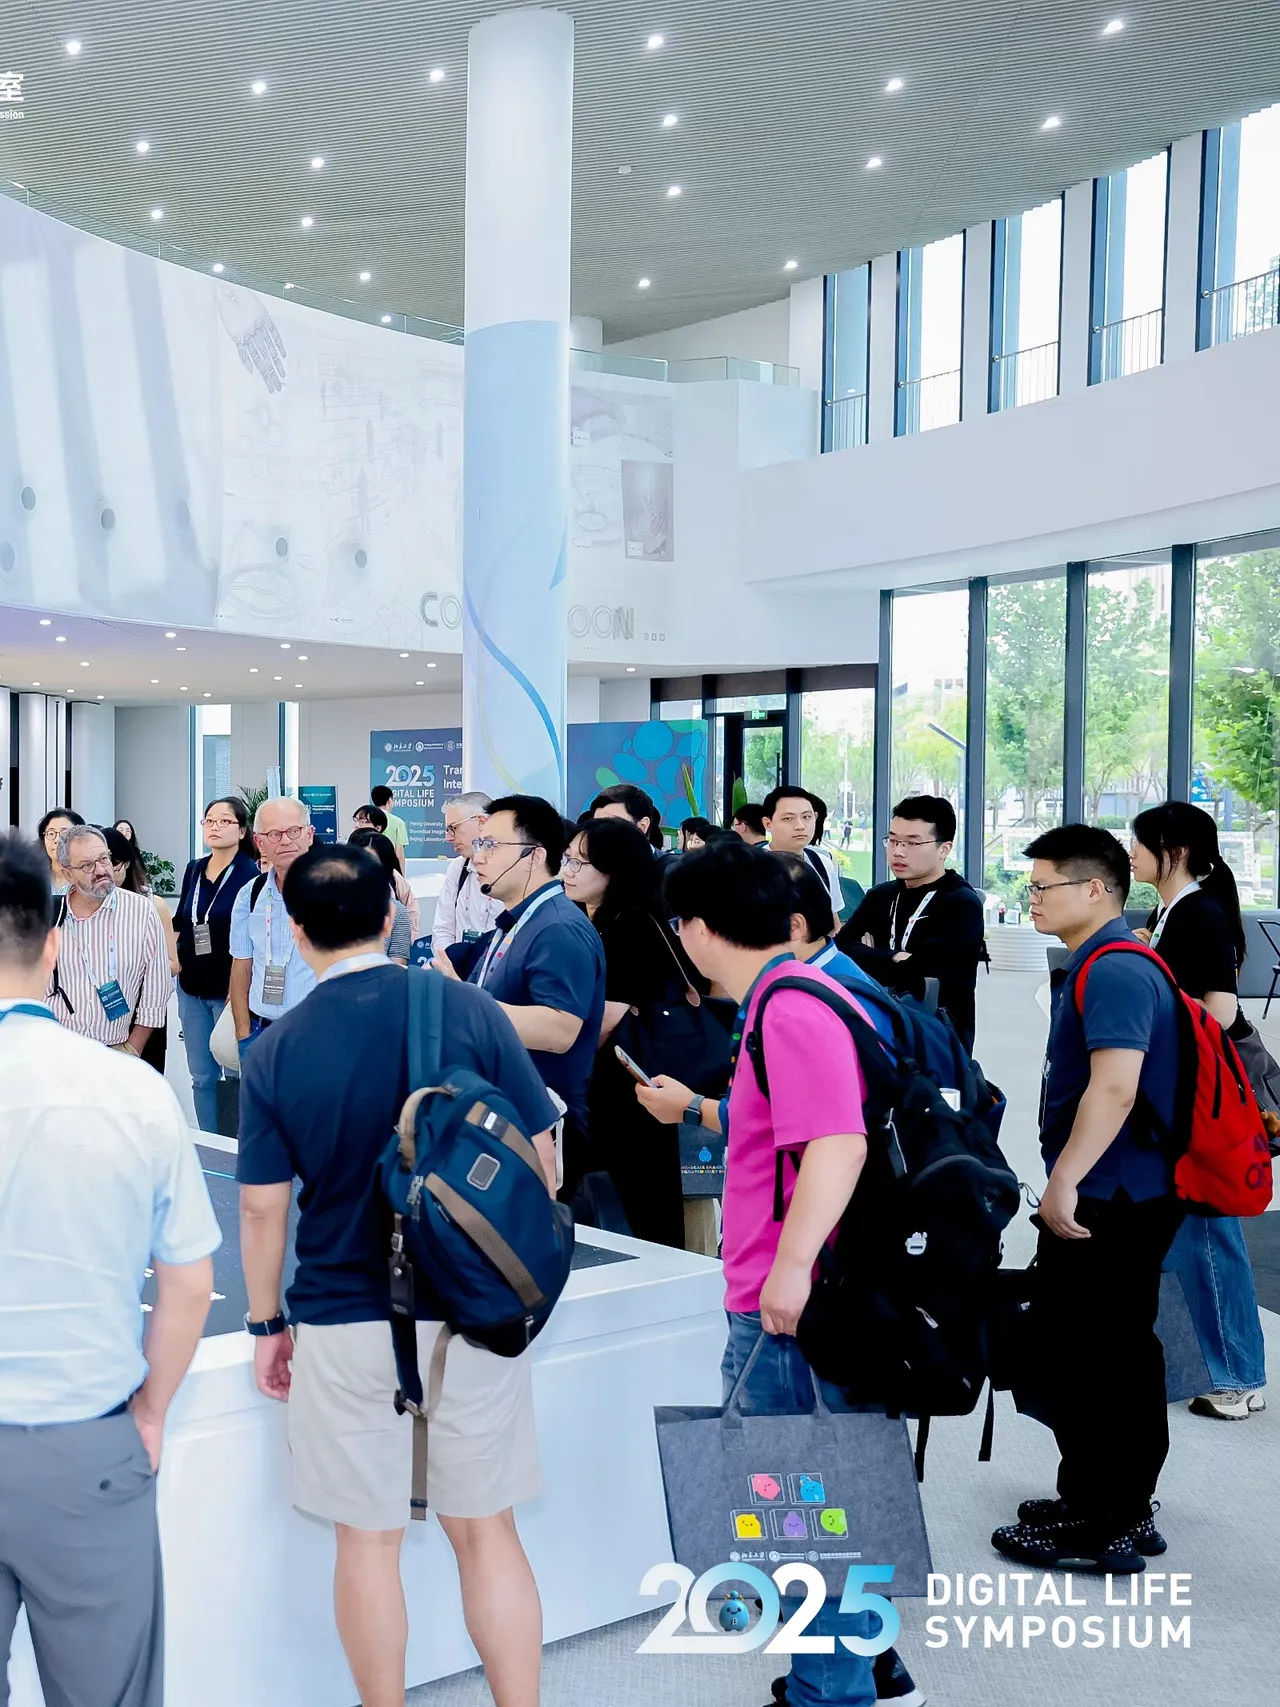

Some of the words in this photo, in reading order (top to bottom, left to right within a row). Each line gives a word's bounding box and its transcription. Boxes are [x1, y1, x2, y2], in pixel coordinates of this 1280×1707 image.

[420, 590, 462, 630] CO
[567, 604, 635, 640] OON
[385, 765, 435, 787] 2025
[392, 789, 414, 798] GITAL
[417, 789, 435, 798] LIFE
[394, 798, 435, 808] MPOSIUM
